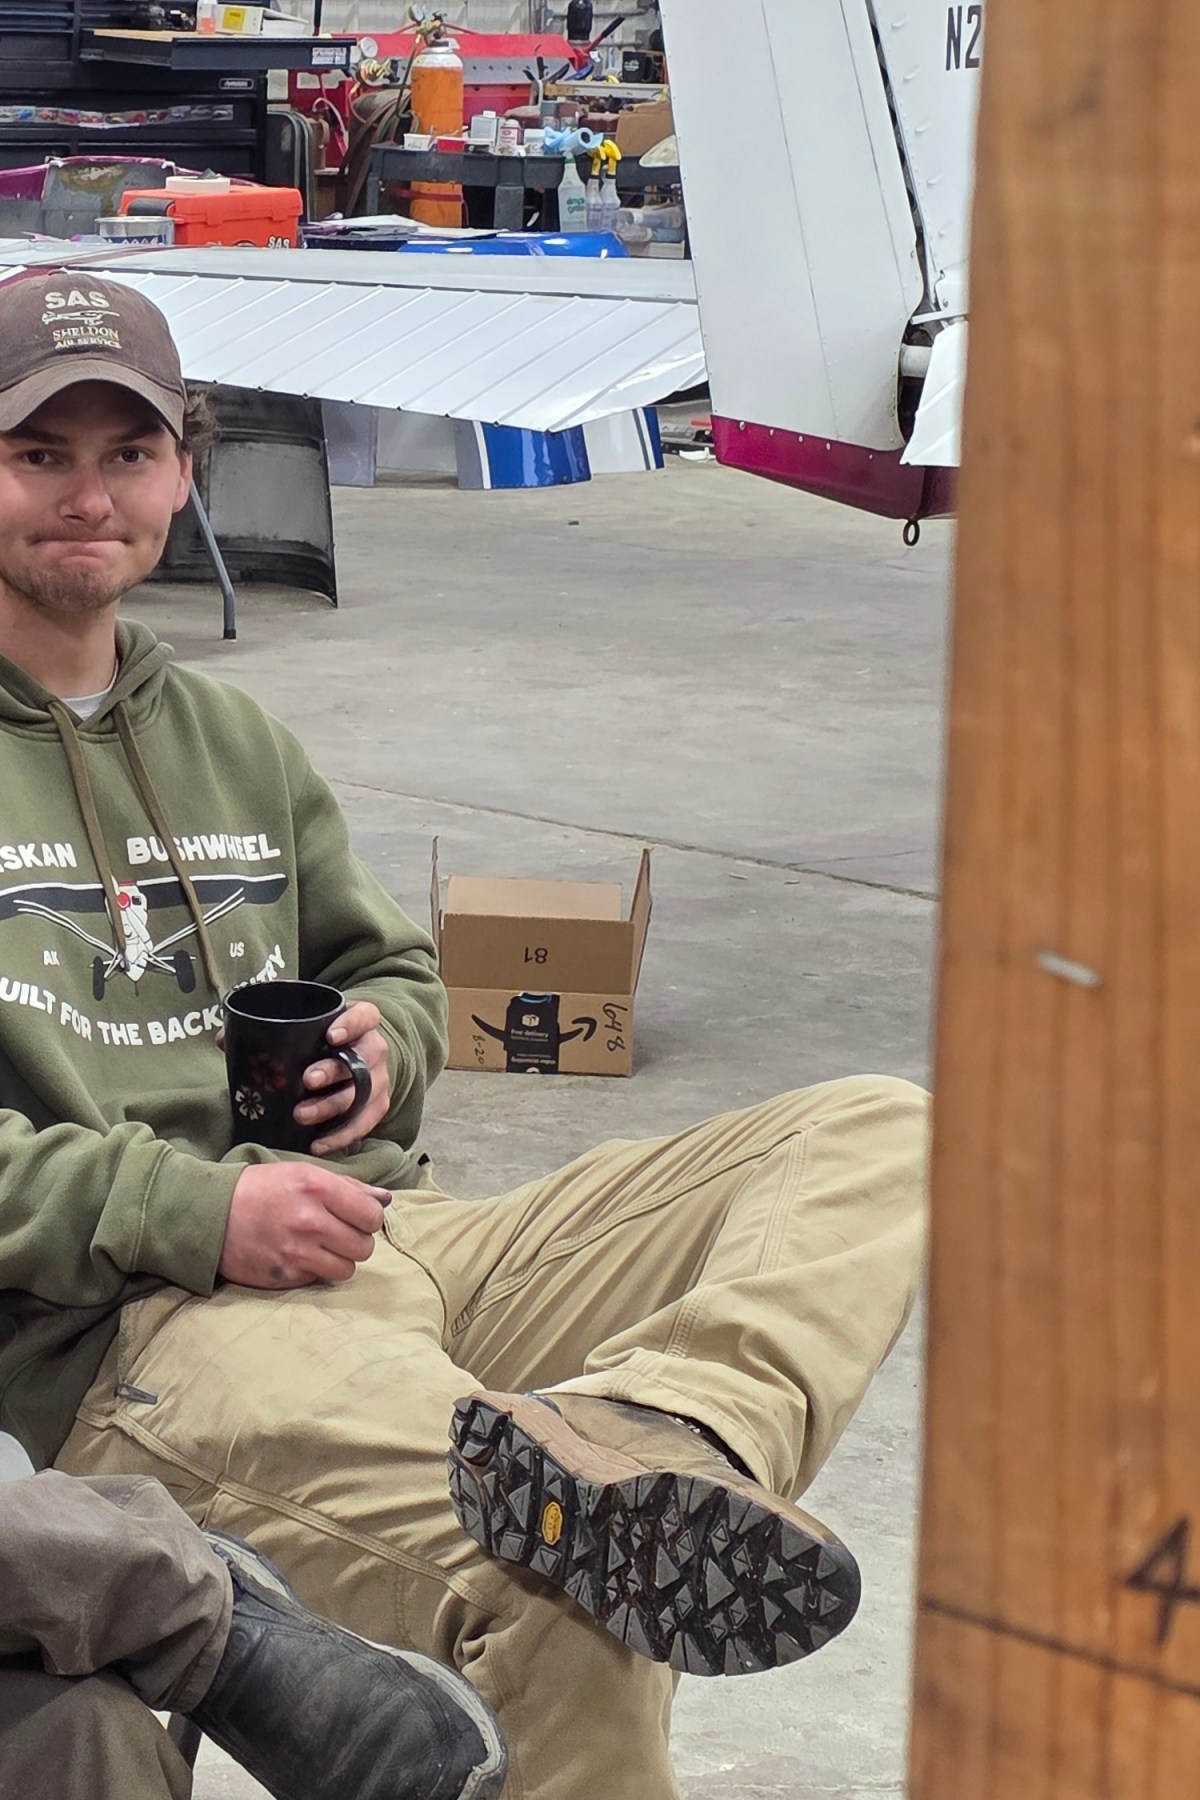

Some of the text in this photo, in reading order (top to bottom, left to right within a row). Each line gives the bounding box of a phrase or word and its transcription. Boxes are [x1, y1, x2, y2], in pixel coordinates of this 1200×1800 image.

[946, 5, 981, 71] N2
[267, 236, 290, 249] SAS
[44, 290, 110, 309] SAS
[52, 326, 120, 342] SHELDON
[127, 834, 281, 865] BUSHWHEEL
[43, 950, 59, 966] AK
[229, 942, 245, 958] US
[524, 947, 548, 964] 81
[60, 1002, 92, 1041] FOR
[97, 1022, 143, 1046] THE
[1121, 1513, 1200, 1648] 4
